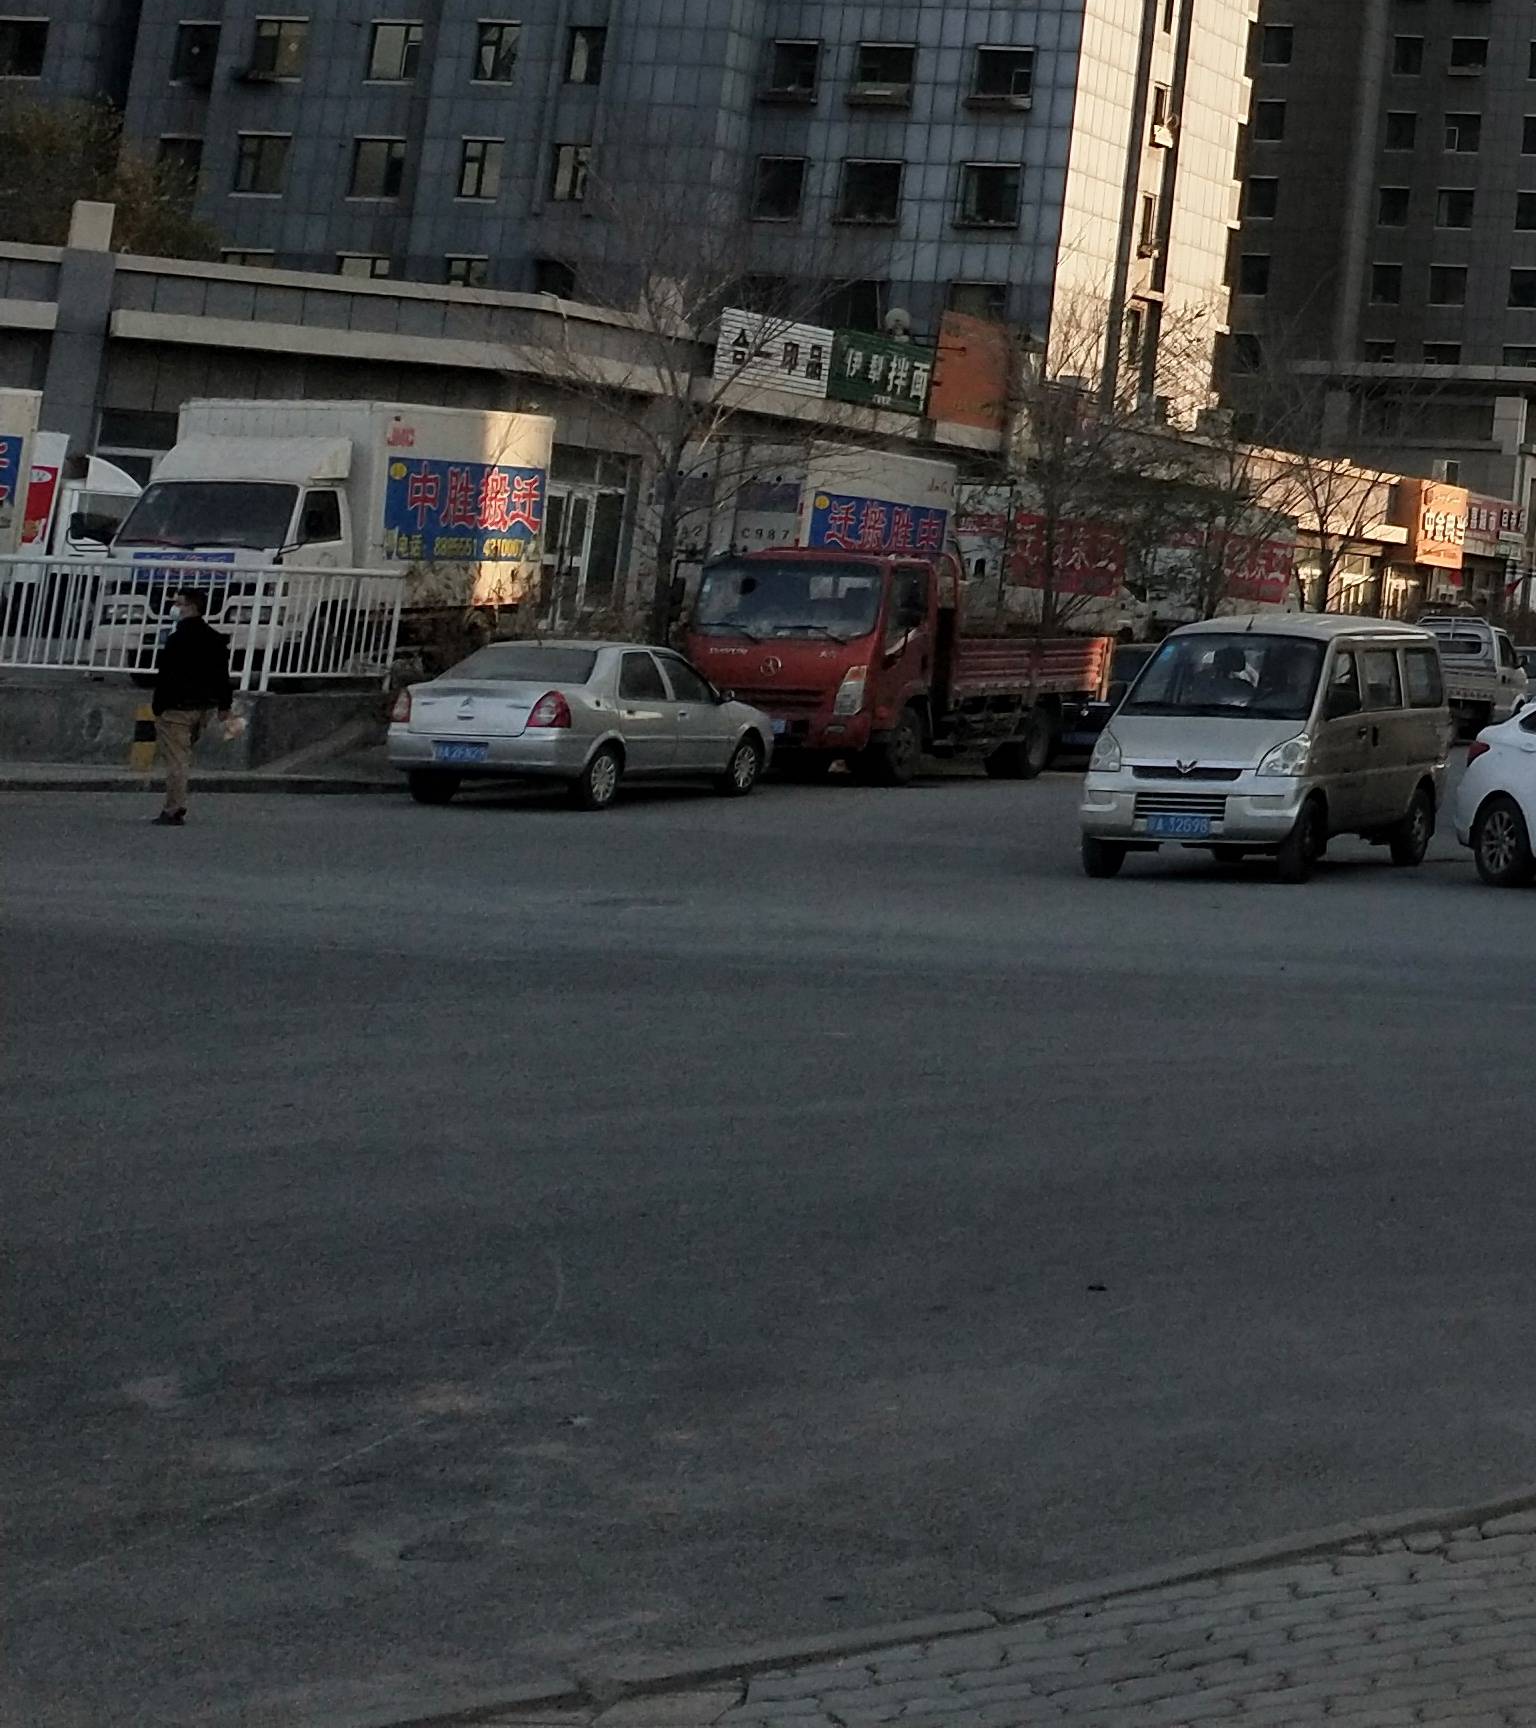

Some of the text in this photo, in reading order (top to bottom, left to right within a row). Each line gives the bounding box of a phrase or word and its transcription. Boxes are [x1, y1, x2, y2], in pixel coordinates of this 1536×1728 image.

[407, 460, 542, 535] 中胜搬迁
[741, 528, 790, 541] C987
